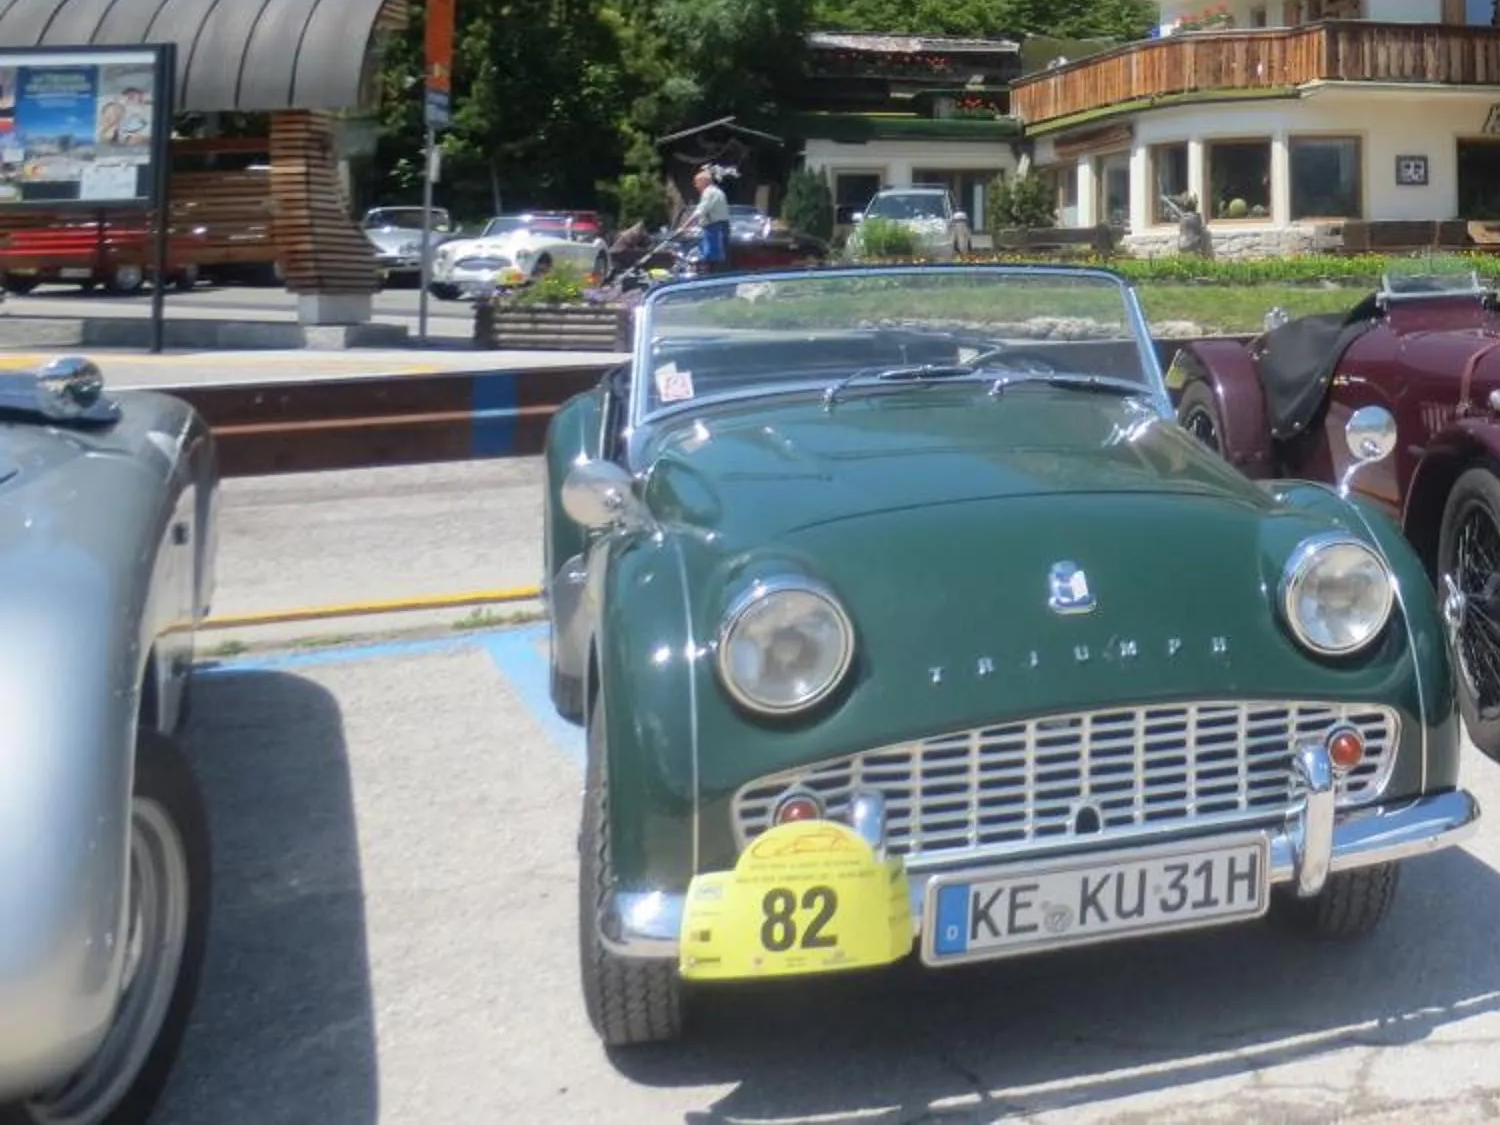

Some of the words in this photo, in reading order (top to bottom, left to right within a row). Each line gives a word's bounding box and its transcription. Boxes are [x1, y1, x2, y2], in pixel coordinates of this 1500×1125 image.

[928, 635, 1227, 683] TRIUMPH
[760, 884, 839, 953] 82
[970, 883, 1040, 940] KE
